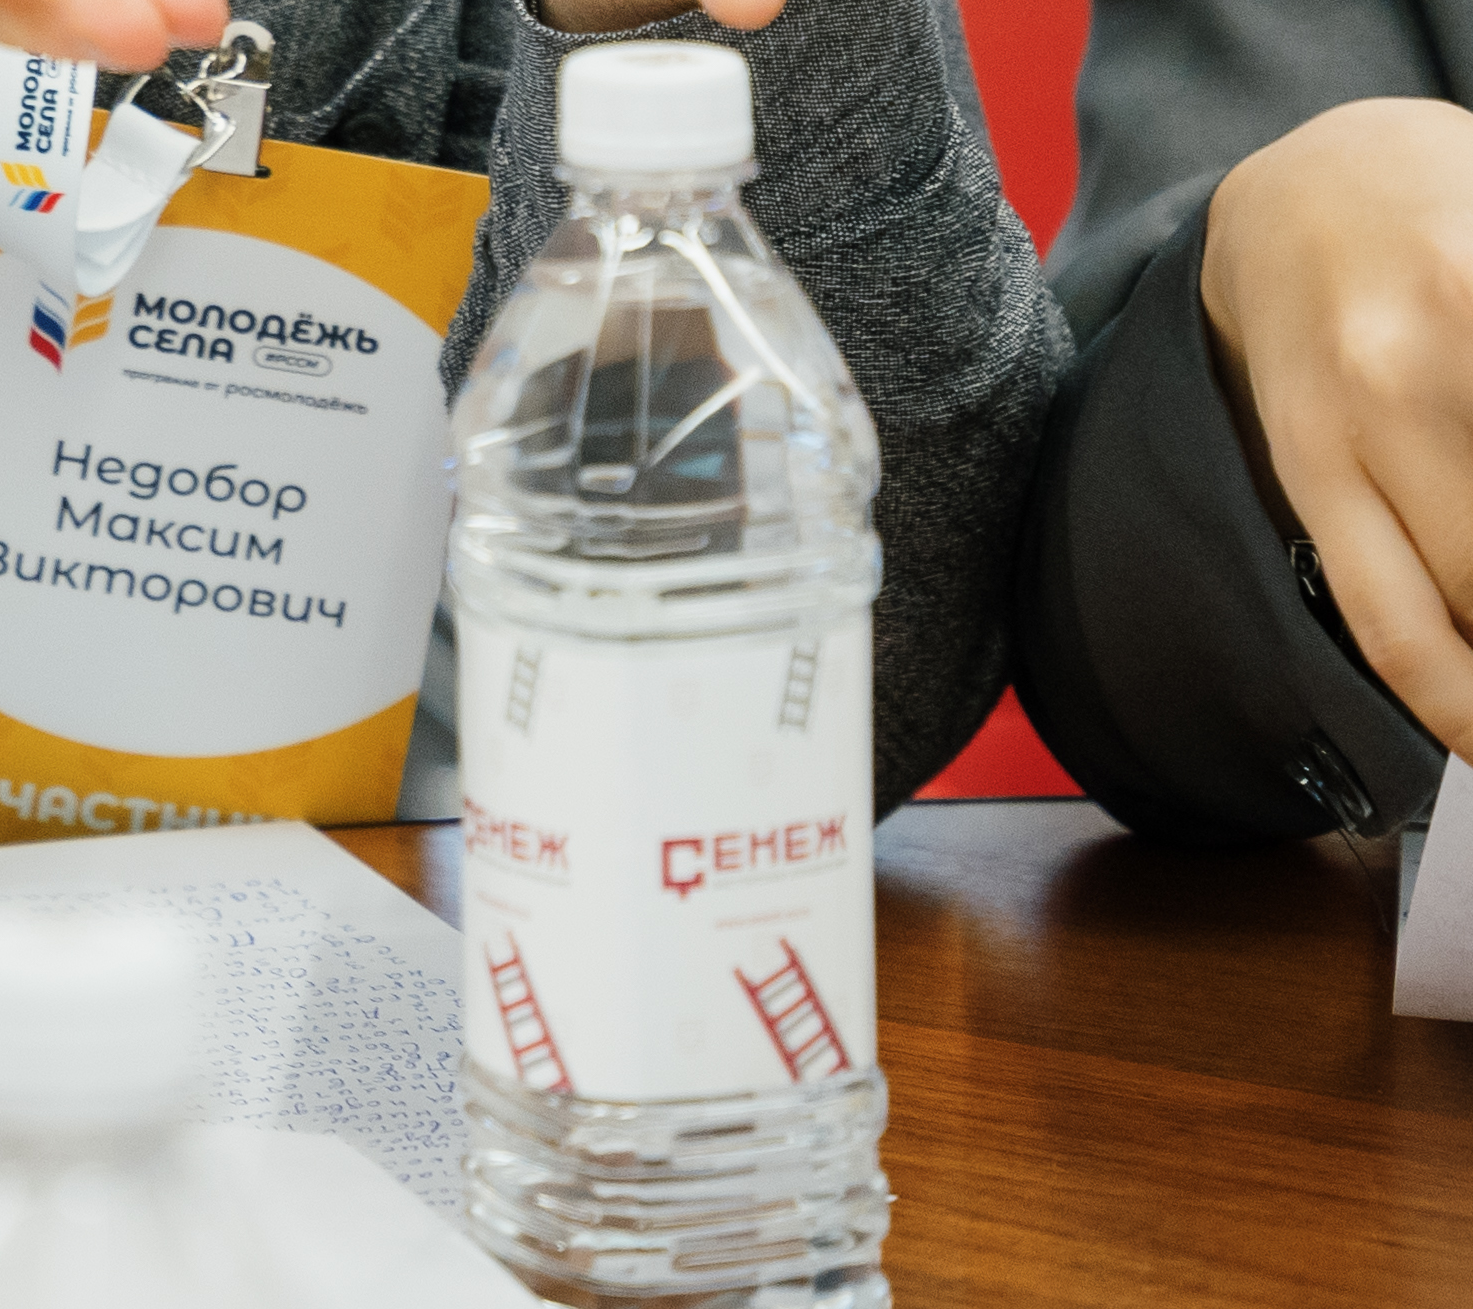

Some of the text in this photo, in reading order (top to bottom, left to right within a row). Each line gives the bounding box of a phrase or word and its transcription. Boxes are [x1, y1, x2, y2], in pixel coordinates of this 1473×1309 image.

[15, 58, 45, 151] МОЛОД
[35, 88, 59, 154] СЕЛА
[128, 324, 235, 364] СЕЛА
[133, 291, 380, 356] МОЛОДЁЖЬ
[53, 439, 308, 521] Недобор
[56, 495, 285, 566] Максим
